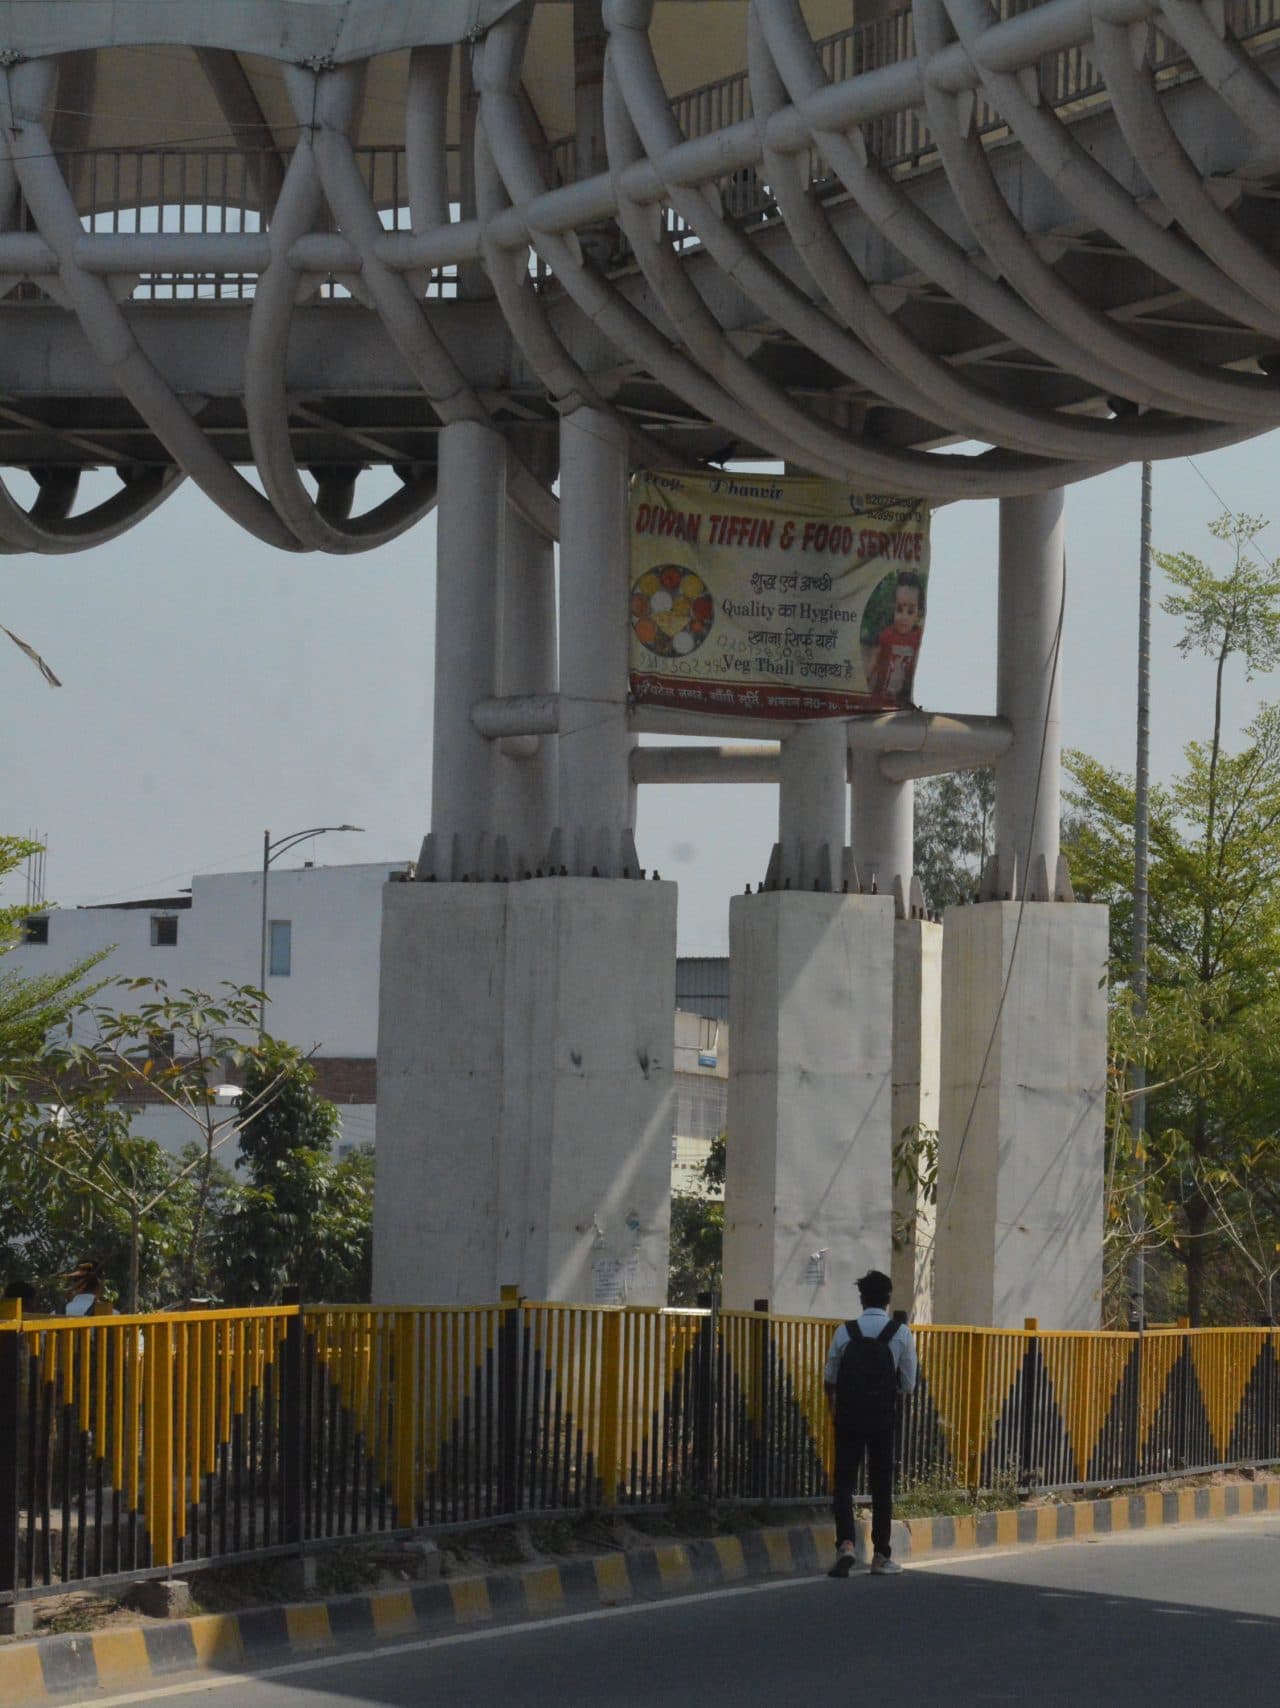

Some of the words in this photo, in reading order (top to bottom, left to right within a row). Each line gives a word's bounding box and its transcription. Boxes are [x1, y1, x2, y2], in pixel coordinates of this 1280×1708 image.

[635, 502, 702, 544] DIWAN
[708, 514, 775, 549] TIFFIN
[779, 520, 796, 550] &
[802, 521, 853, 555] FOOD
[857, 527, 923, 562] SERVICE
[779, 570, 799, 593] एवं
[800, 572, 833, 592] अच्छी
[721, 597, 775, 622] Quality
[777, 603, 797, 617] का
[799, 602, 858, 624] Hygiene
[748, 629, 783, 647] खाना
[784, 627, 814, 648] सिर्फ
[722, 653, 752, 674] Veg
[755, 656, 794, 676] Thali
